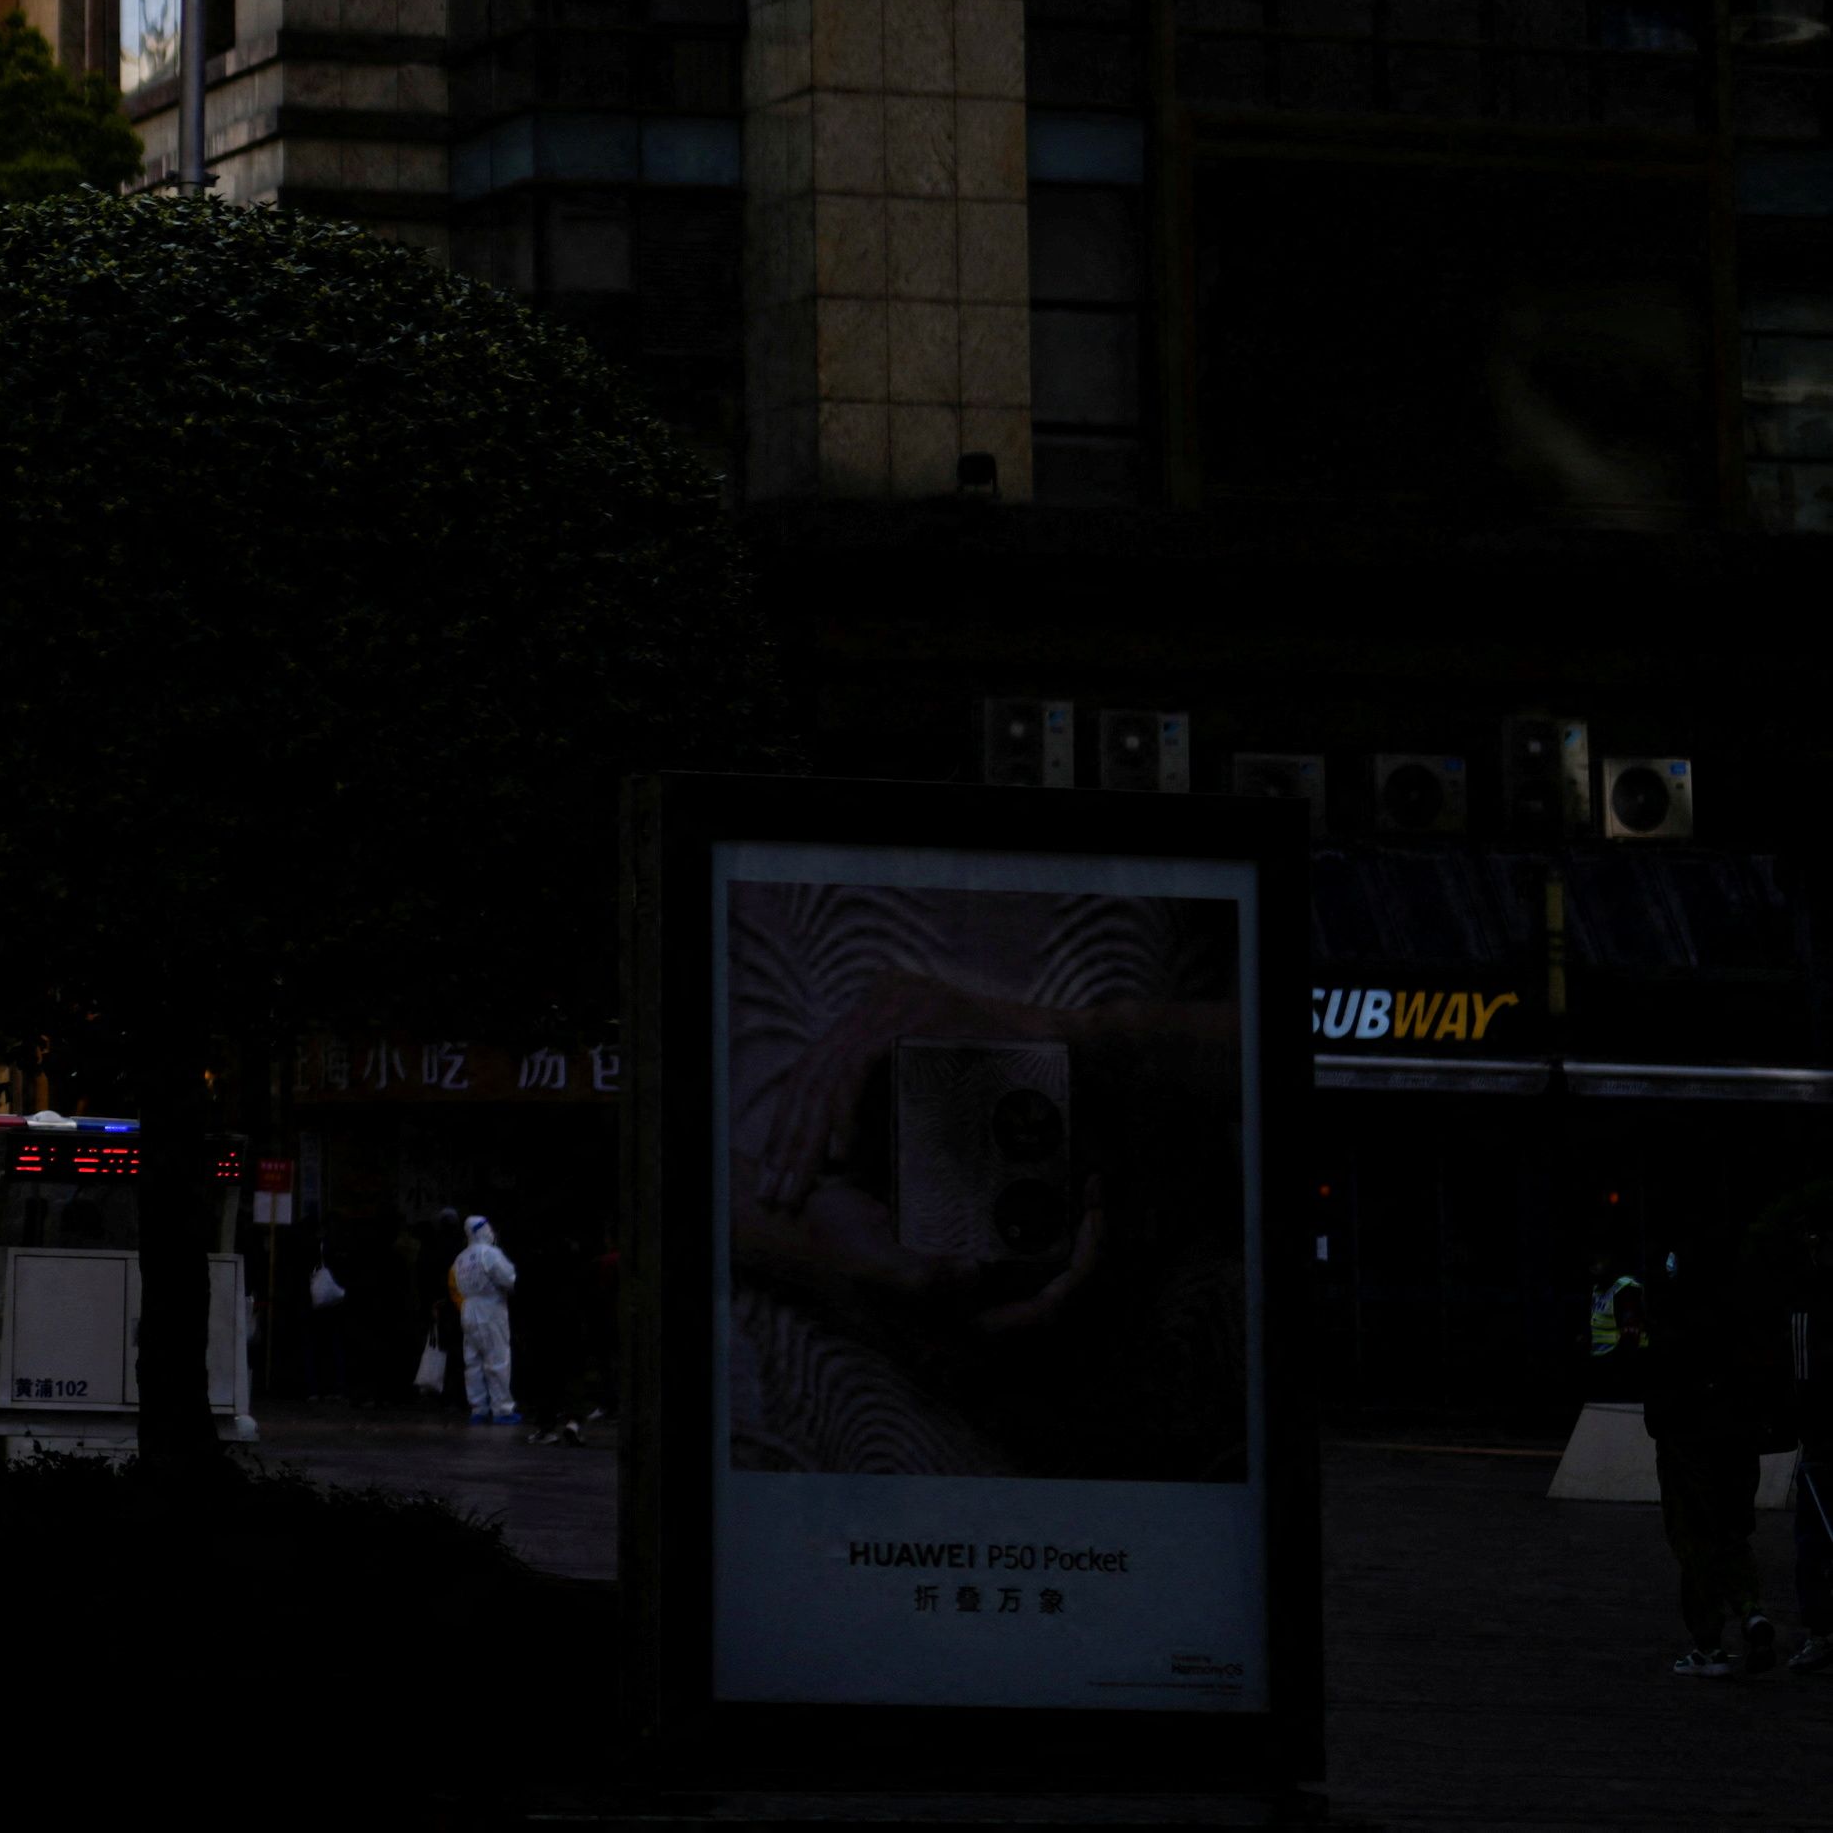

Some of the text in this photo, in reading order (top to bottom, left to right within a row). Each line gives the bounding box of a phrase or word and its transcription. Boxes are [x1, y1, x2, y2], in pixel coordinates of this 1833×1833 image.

[14, 1377, 88, 1399] 黄浦102
[849, 1541, 1129, 1573] HUAWEI P50 Pocket
[914, 1584, 1065, 1615] 折叠万象
